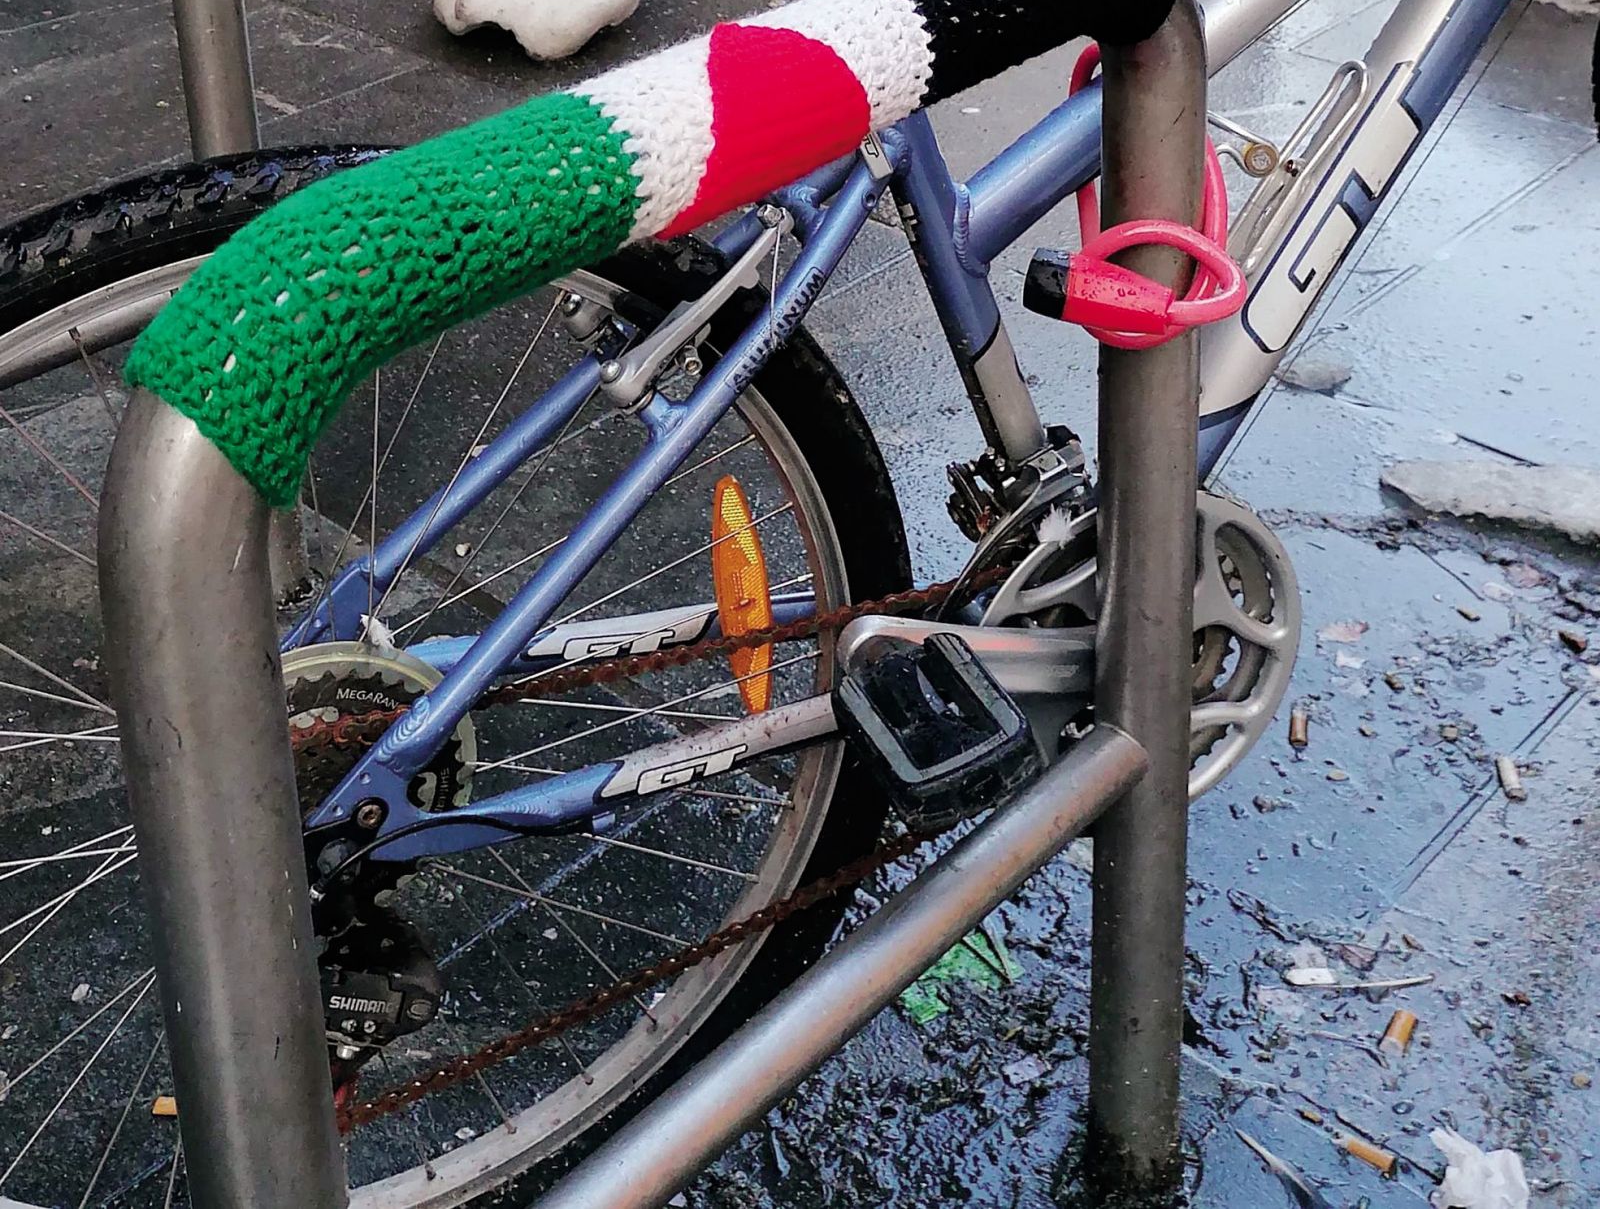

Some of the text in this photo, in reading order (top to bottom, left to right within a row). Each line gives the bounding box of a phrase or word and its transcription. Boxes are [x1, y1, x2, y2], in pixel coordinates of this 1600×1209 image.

[1241, 60, 1423, 353] GT
[563, 628, 675, 661] GT
[637, 743, 748, 796] GT
